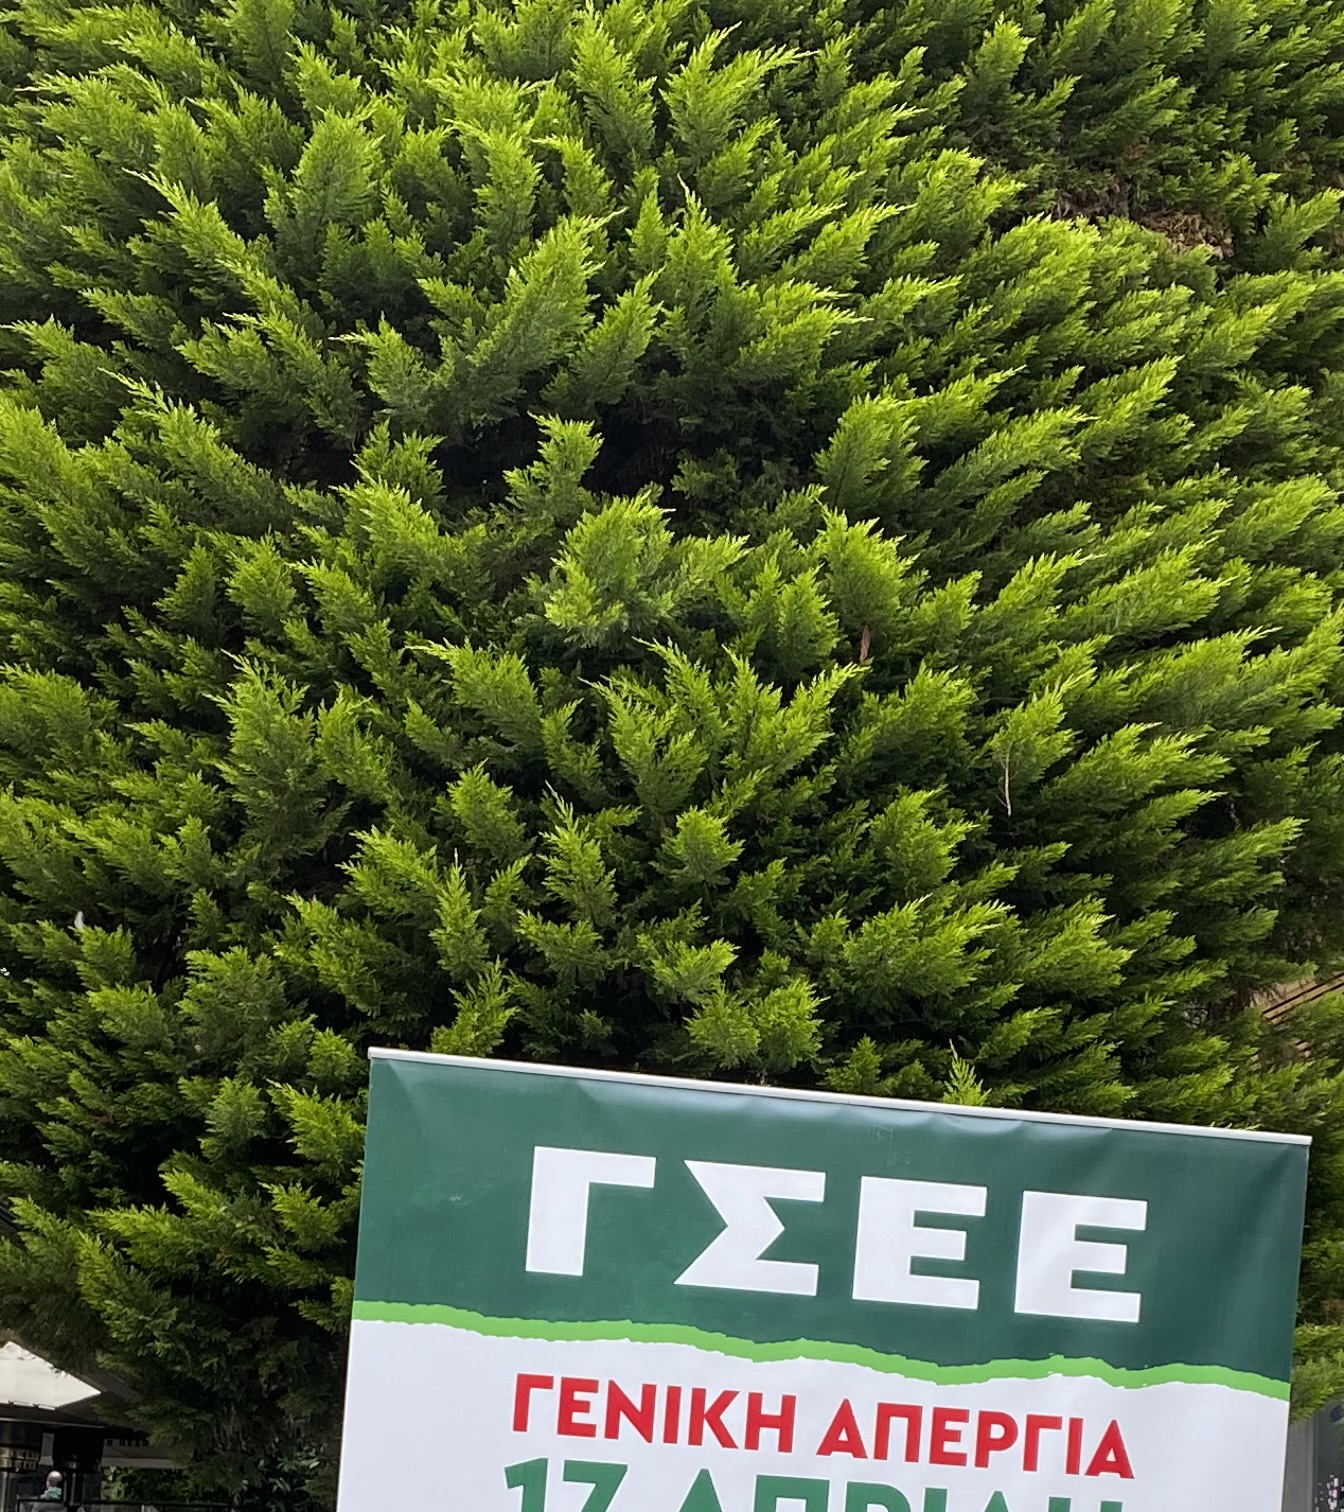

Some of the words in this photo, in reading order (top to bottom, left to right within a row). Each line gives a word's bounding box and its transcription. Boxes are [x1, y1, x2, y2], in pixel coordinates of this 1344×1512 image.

[525, 1145, 1148, 1323] ΓΣΕΕ
[512, 1373, 797, 1454] ΓΕΝΙΚΗ
[818, 1397, 1135, 1480] ΑΠΕΡΓΙΑ
